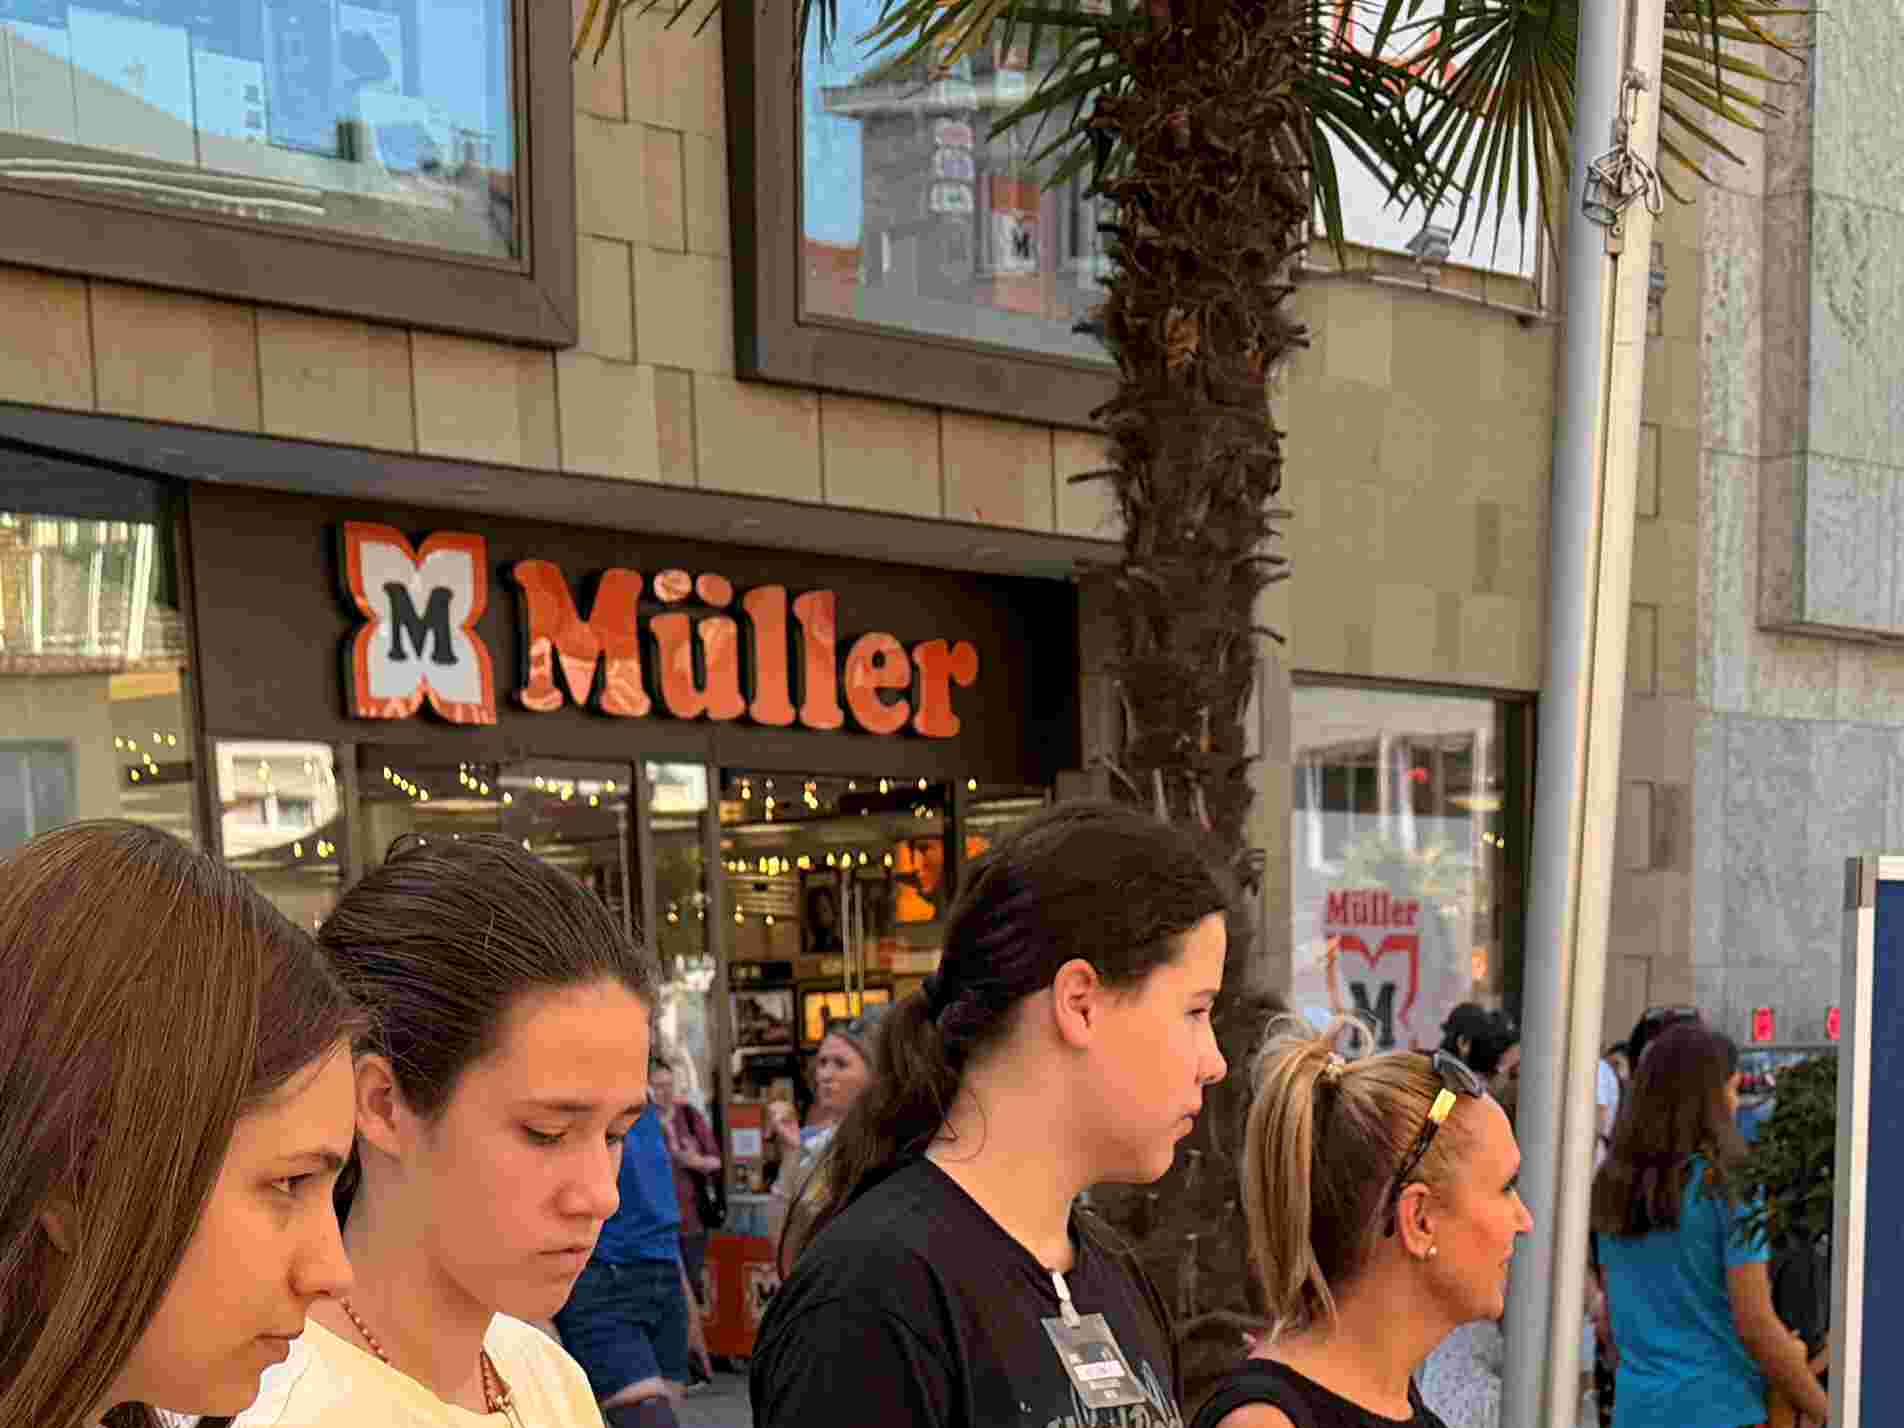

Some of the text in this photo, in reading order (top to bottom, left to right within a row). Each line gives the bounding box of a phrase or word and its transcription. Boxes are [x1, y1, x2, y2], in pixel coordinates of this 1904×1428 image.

[383, 581, 457, 665] M
[512, 559, 978, 738] Müller
[1327, 889, 1420, 927] Müller
